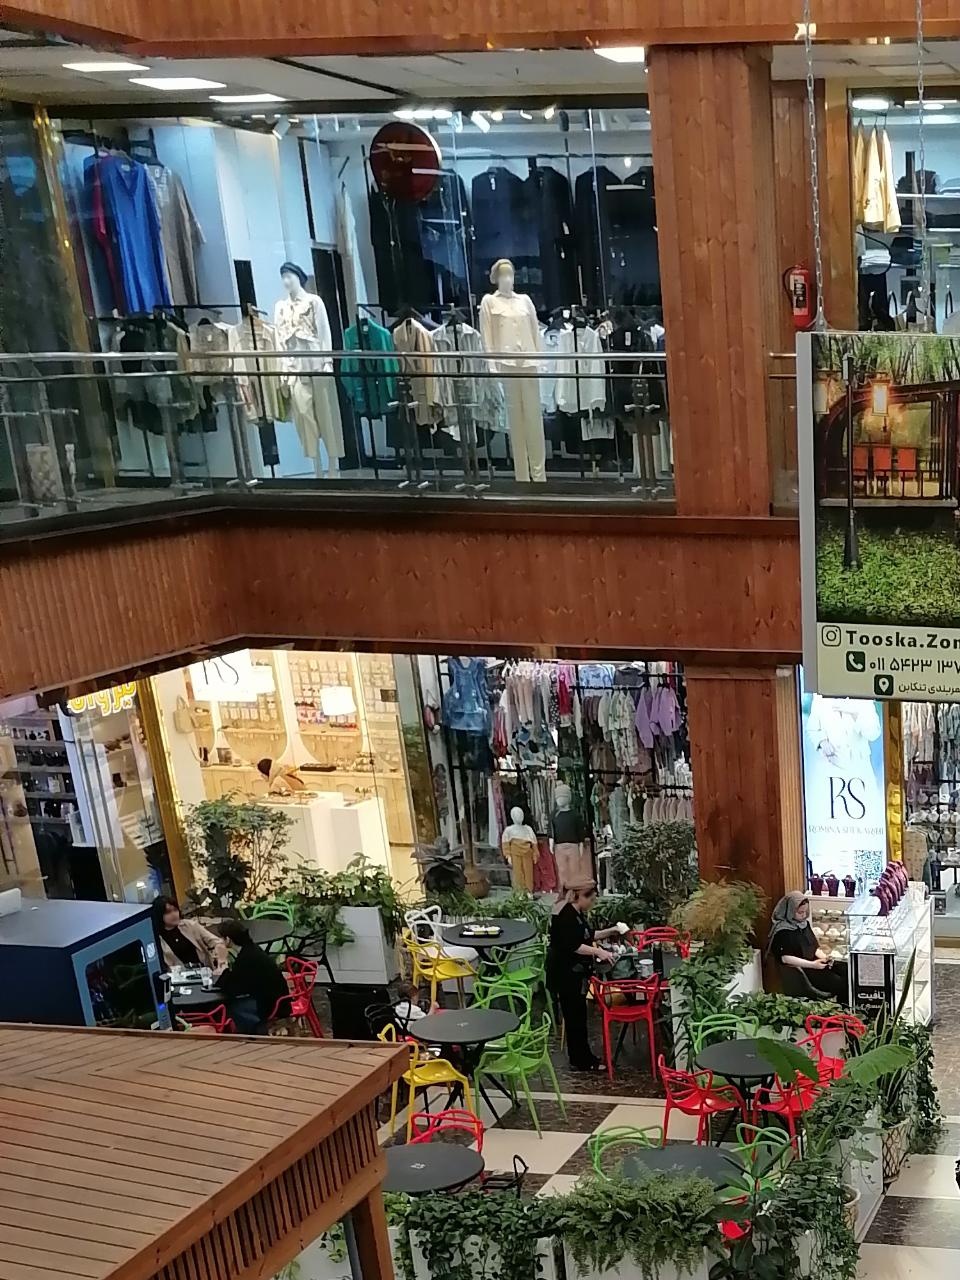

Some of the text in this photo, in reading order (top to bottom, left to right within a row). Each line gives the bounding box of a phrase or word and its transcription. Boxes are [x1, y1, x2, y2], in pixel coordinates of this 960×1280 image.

[869, 658, 885, 671] ۰۱۱
[890, 657, 932, 673] ۵۴۲۳
[898, 682, 927, 693] تنکابن
[828, 776, 866, 820] RS
